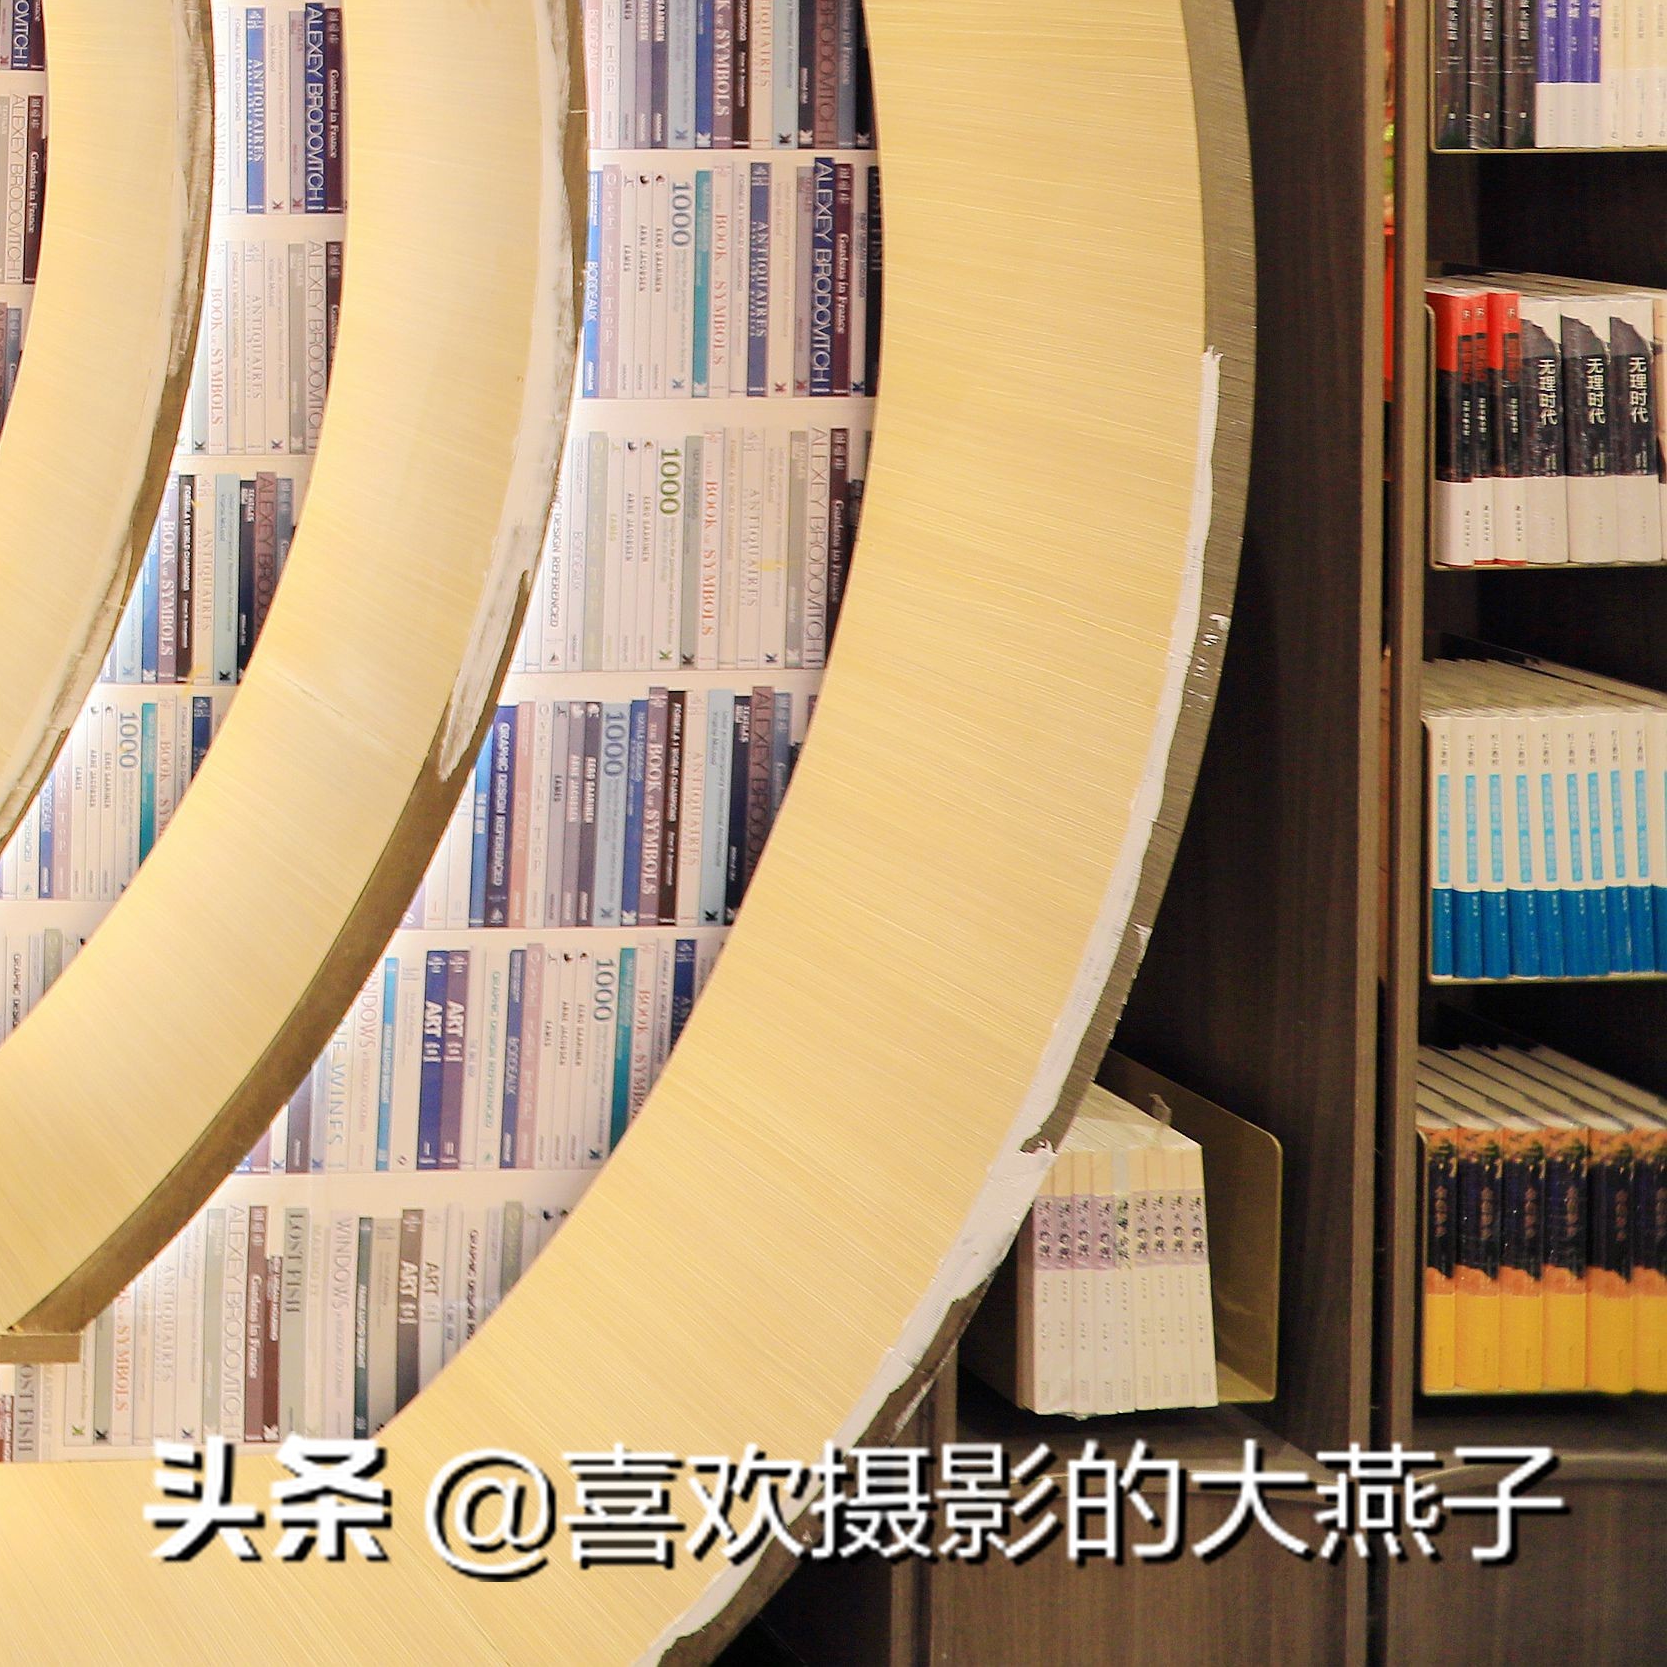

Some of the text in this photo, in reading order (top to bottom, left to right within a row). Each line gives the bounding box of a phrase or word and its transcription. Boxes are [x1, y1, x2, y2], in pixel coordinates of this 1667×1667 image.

[253, 59, 265, 163] ANTIQUAIRES
[306, 6, 325, 201] ALEXEY BRODOVITCH
[328, 68, 341, 159] Gardens France
[715, 27, 730, 118] SYMBOLS
[11, 94, 27, 158] ALEXEY
[28, 150, 40, 234] Gardens France
[671, 180, 693, 247] 1000
[307, 240, 324, 312] ALEXEY
[712, 213, 729, 367] BOOK SYMBOLS
[756, 220, 769, 339] ANTIQUAIRES
[813, 160, 833, 383] ALEXEY BRODOVITCH
[835, 233, 850, 335] Gardens France
[210, 288, 224, 426] BOOK SYMBOLS
[252, 295, 263, 400] ANTIQUAIRES
[1538, 358, 1558, 426] 无理时代
[1585, 357, 1606, 425] 无理时代
[1628, 356, 1649, 424] 无理时代
[257, 474, 276, 549] ALEXEY
[659, 447, 682, 516] 1000
[810, 427, 829, 512] ALEXEY
[160, 520, 176, 657] BOOK SYMBOLS
[201, 531, 213, 632] ANTIQUAIRES
[550, 512, 563, 628] DESIGN REFERENCED
[701, 481, 718, 636] BOOK SYMBOLS
[746, 489, 760, 609] ANTIQUAIRES
[603, 710, 627, 778] 1000
[753, 690, 773, 777] ALEXEY
[492, 722, 511, 887] GRAPHIC DESIGN REFERENCED
[585, 755, 597, 824] EERO SAARINEN
[640, 742, 664, 896] BOOK SYMBOLS
[686, 751, 704, 866] ANTIQUAIRES
[424, 1000, 444, 1039] ART
[446, 1000, 466, 1039] ART
[594, 958, 616, 1021] 1000
[635, 989, 651, 1035] BOOK
[327, 1064, 348, 1147] WINES
[285, 1214, 304, 1313] LOST FISH
[331, 1217, 354, 1312] WINDOWS
[399, 1260, 419, 1299] ART
[423, 1262, 441, 1297] ART
